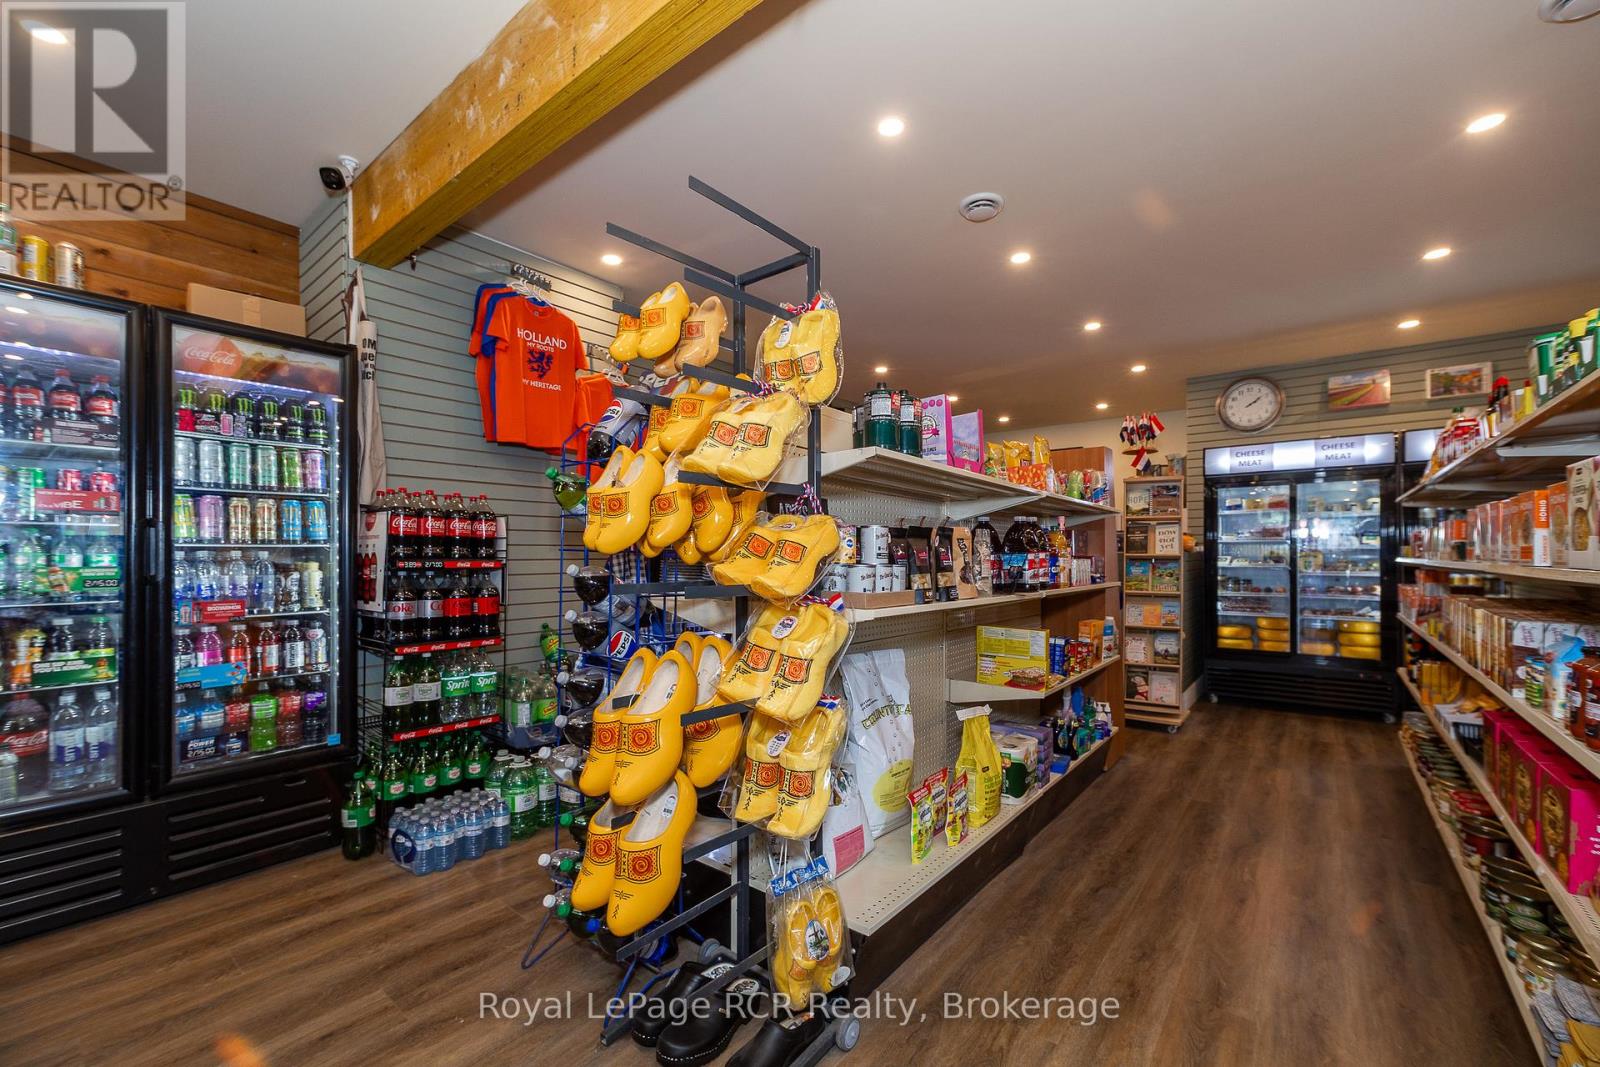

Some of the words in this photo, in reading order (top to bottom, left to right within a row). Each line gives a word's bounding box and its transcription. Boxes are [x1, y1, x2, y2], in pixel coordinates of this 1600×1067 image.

[517, 328, 567, 349] HOLLAND
[537, 344, 555, 353] ROOTS
[530, 380, 562, 391] HERITAGE
[1321, 442, 1356, 451] CHEESE
[1235, 450, 1266, 458] CHEESE
[1325, 452, 1352, 461] MEAT
[1238, 459, 1263, 467] MEAT
